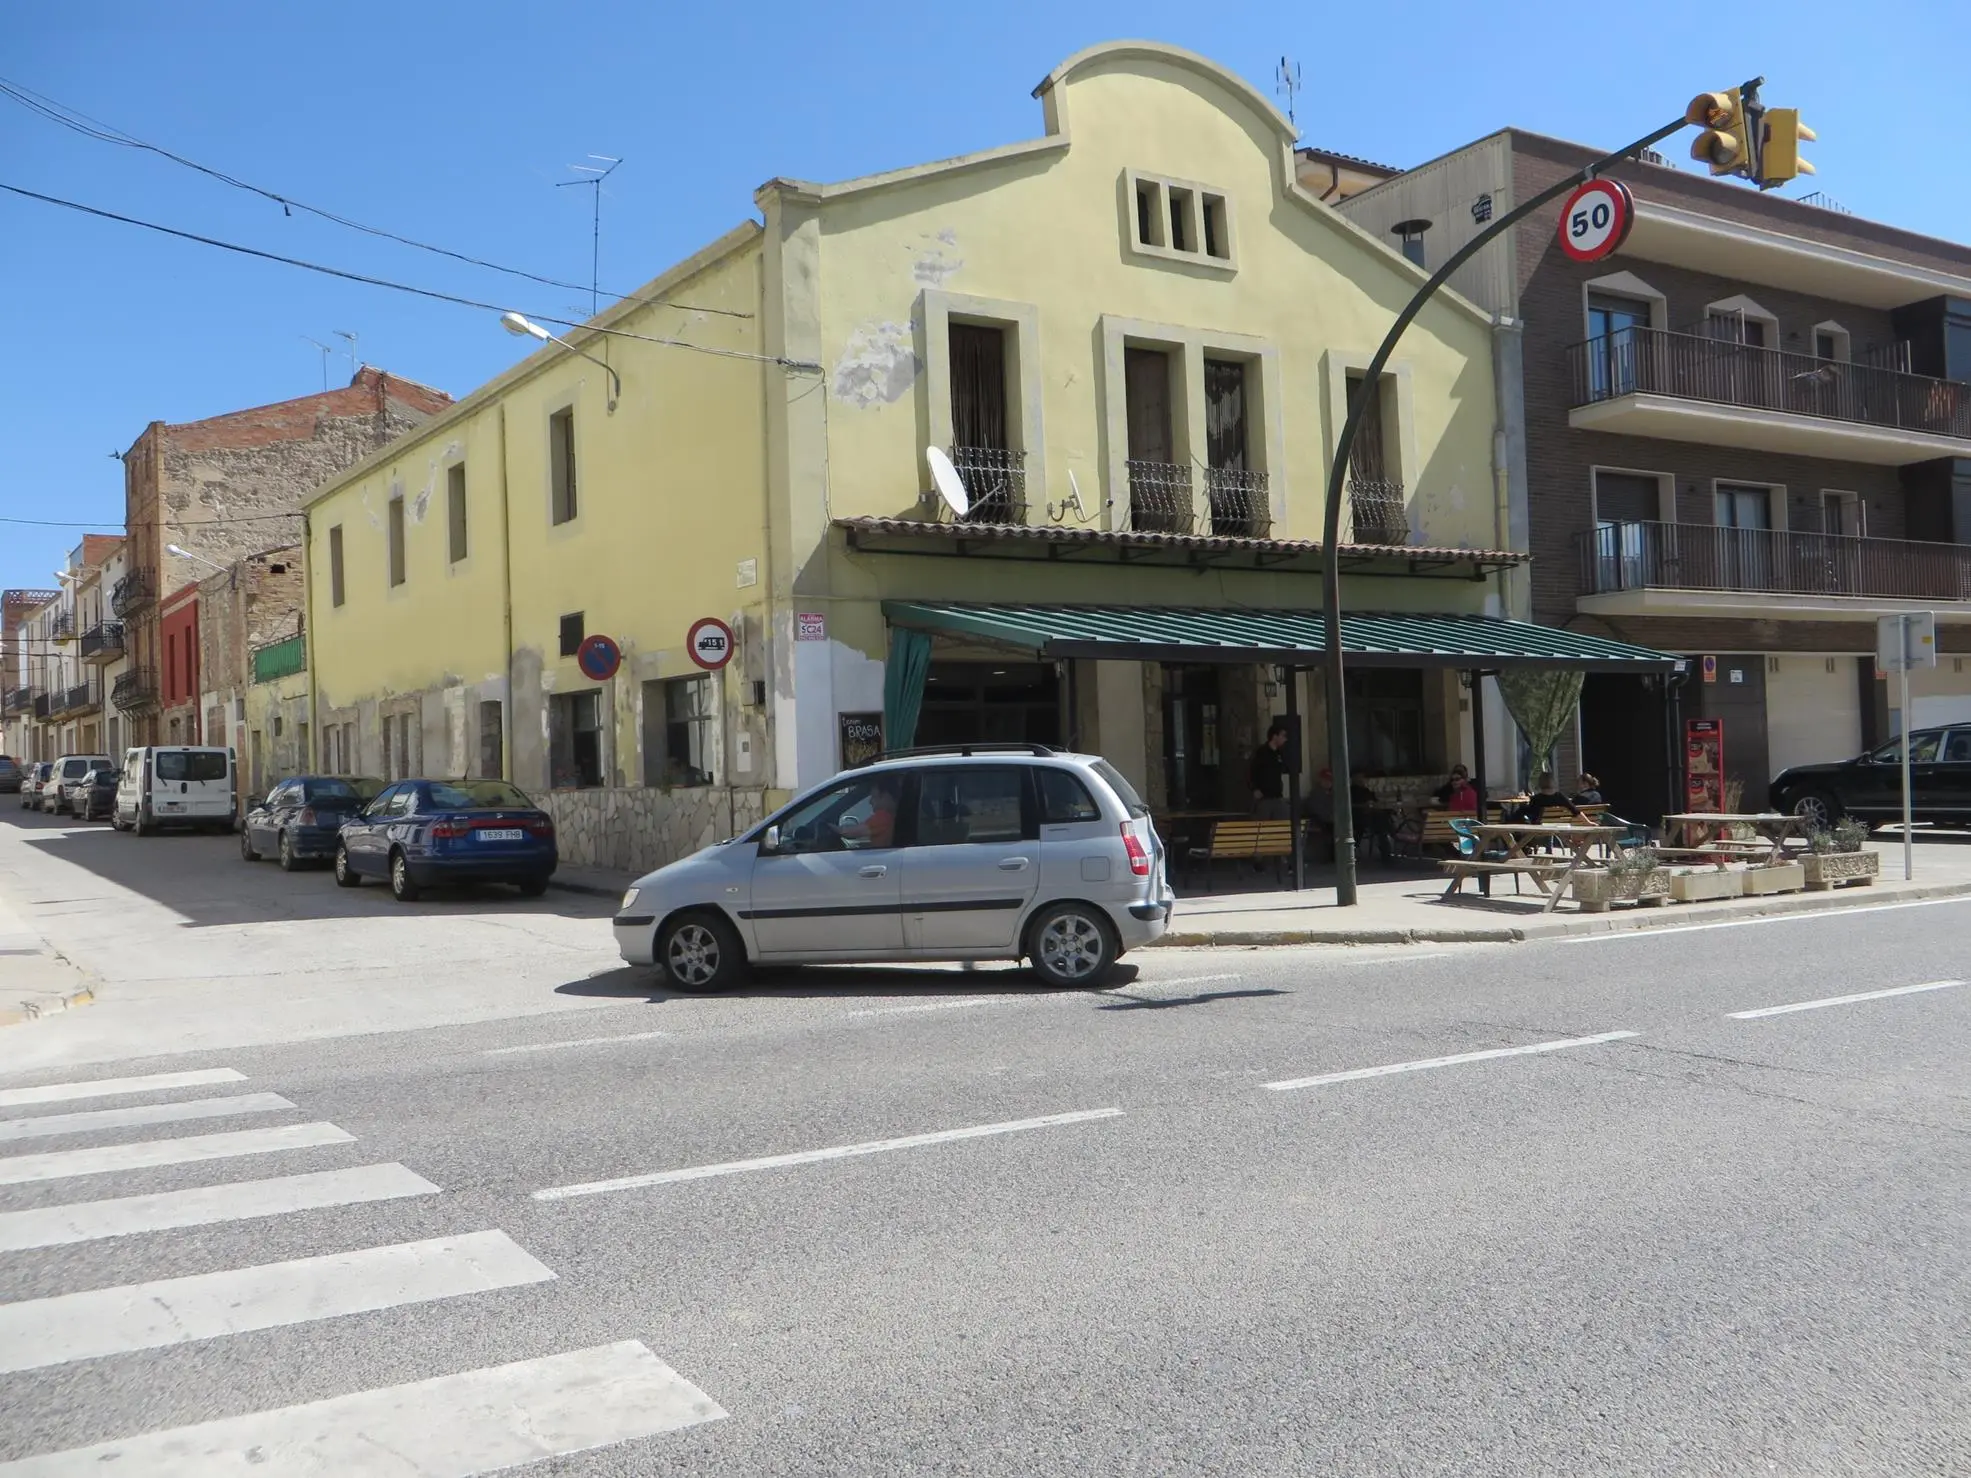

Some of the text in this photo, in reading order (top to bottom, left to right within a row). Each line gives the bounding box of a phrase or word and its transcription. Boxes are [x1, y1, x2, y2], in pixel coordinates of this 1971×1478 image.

[1572, 203, 1609, 238] 50
[708, 639, 717, 647] 15
[848, 724, 881, 740] BRASA
